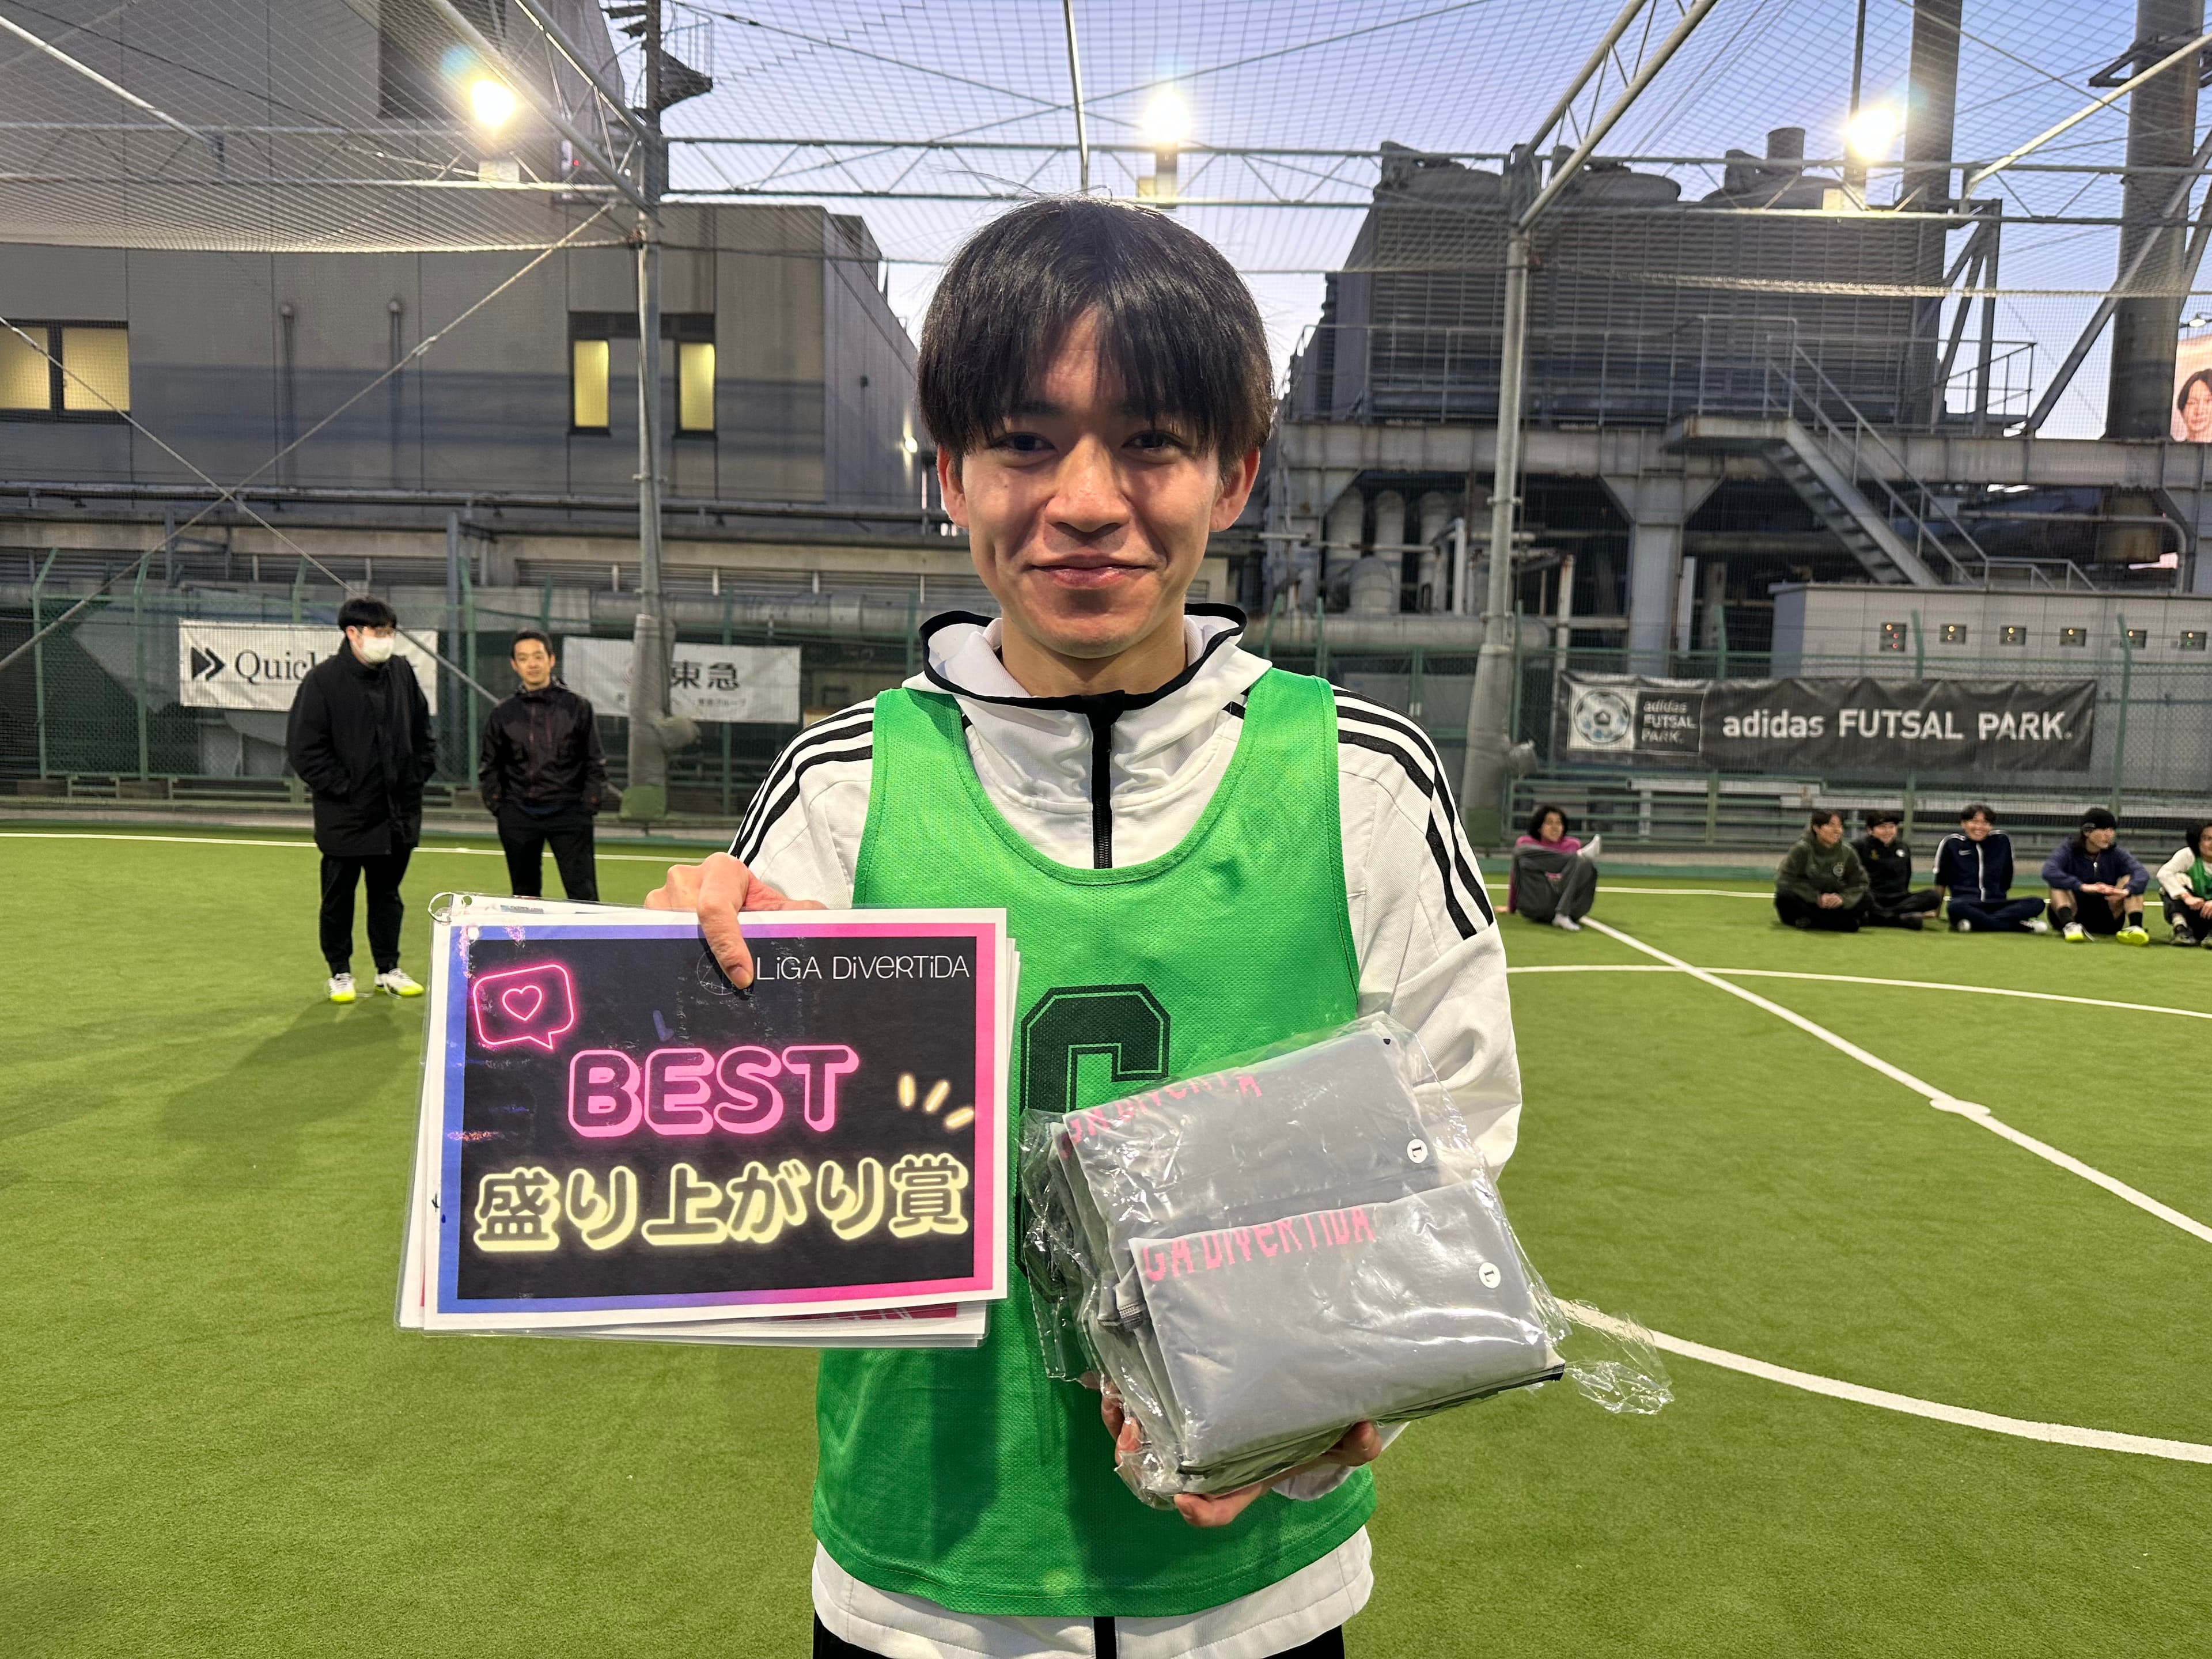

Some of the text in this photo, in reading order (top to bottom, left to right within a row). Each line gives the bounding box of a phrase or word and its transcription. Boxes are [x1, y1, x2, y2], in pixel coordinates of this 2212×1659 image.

[671, 660, 740, 691] 東急
[1643, 700, 1687, 714] adidas
[1643, 714, 1697, 729] FUTSAL
[1723, 709, 1824, 738] adidas
[1838, 709, 1965, 740] FUTSAL
[567, 1044, 860, 1138] BEST
[472, 1152, 971, 1252] 盛り上がり賞
